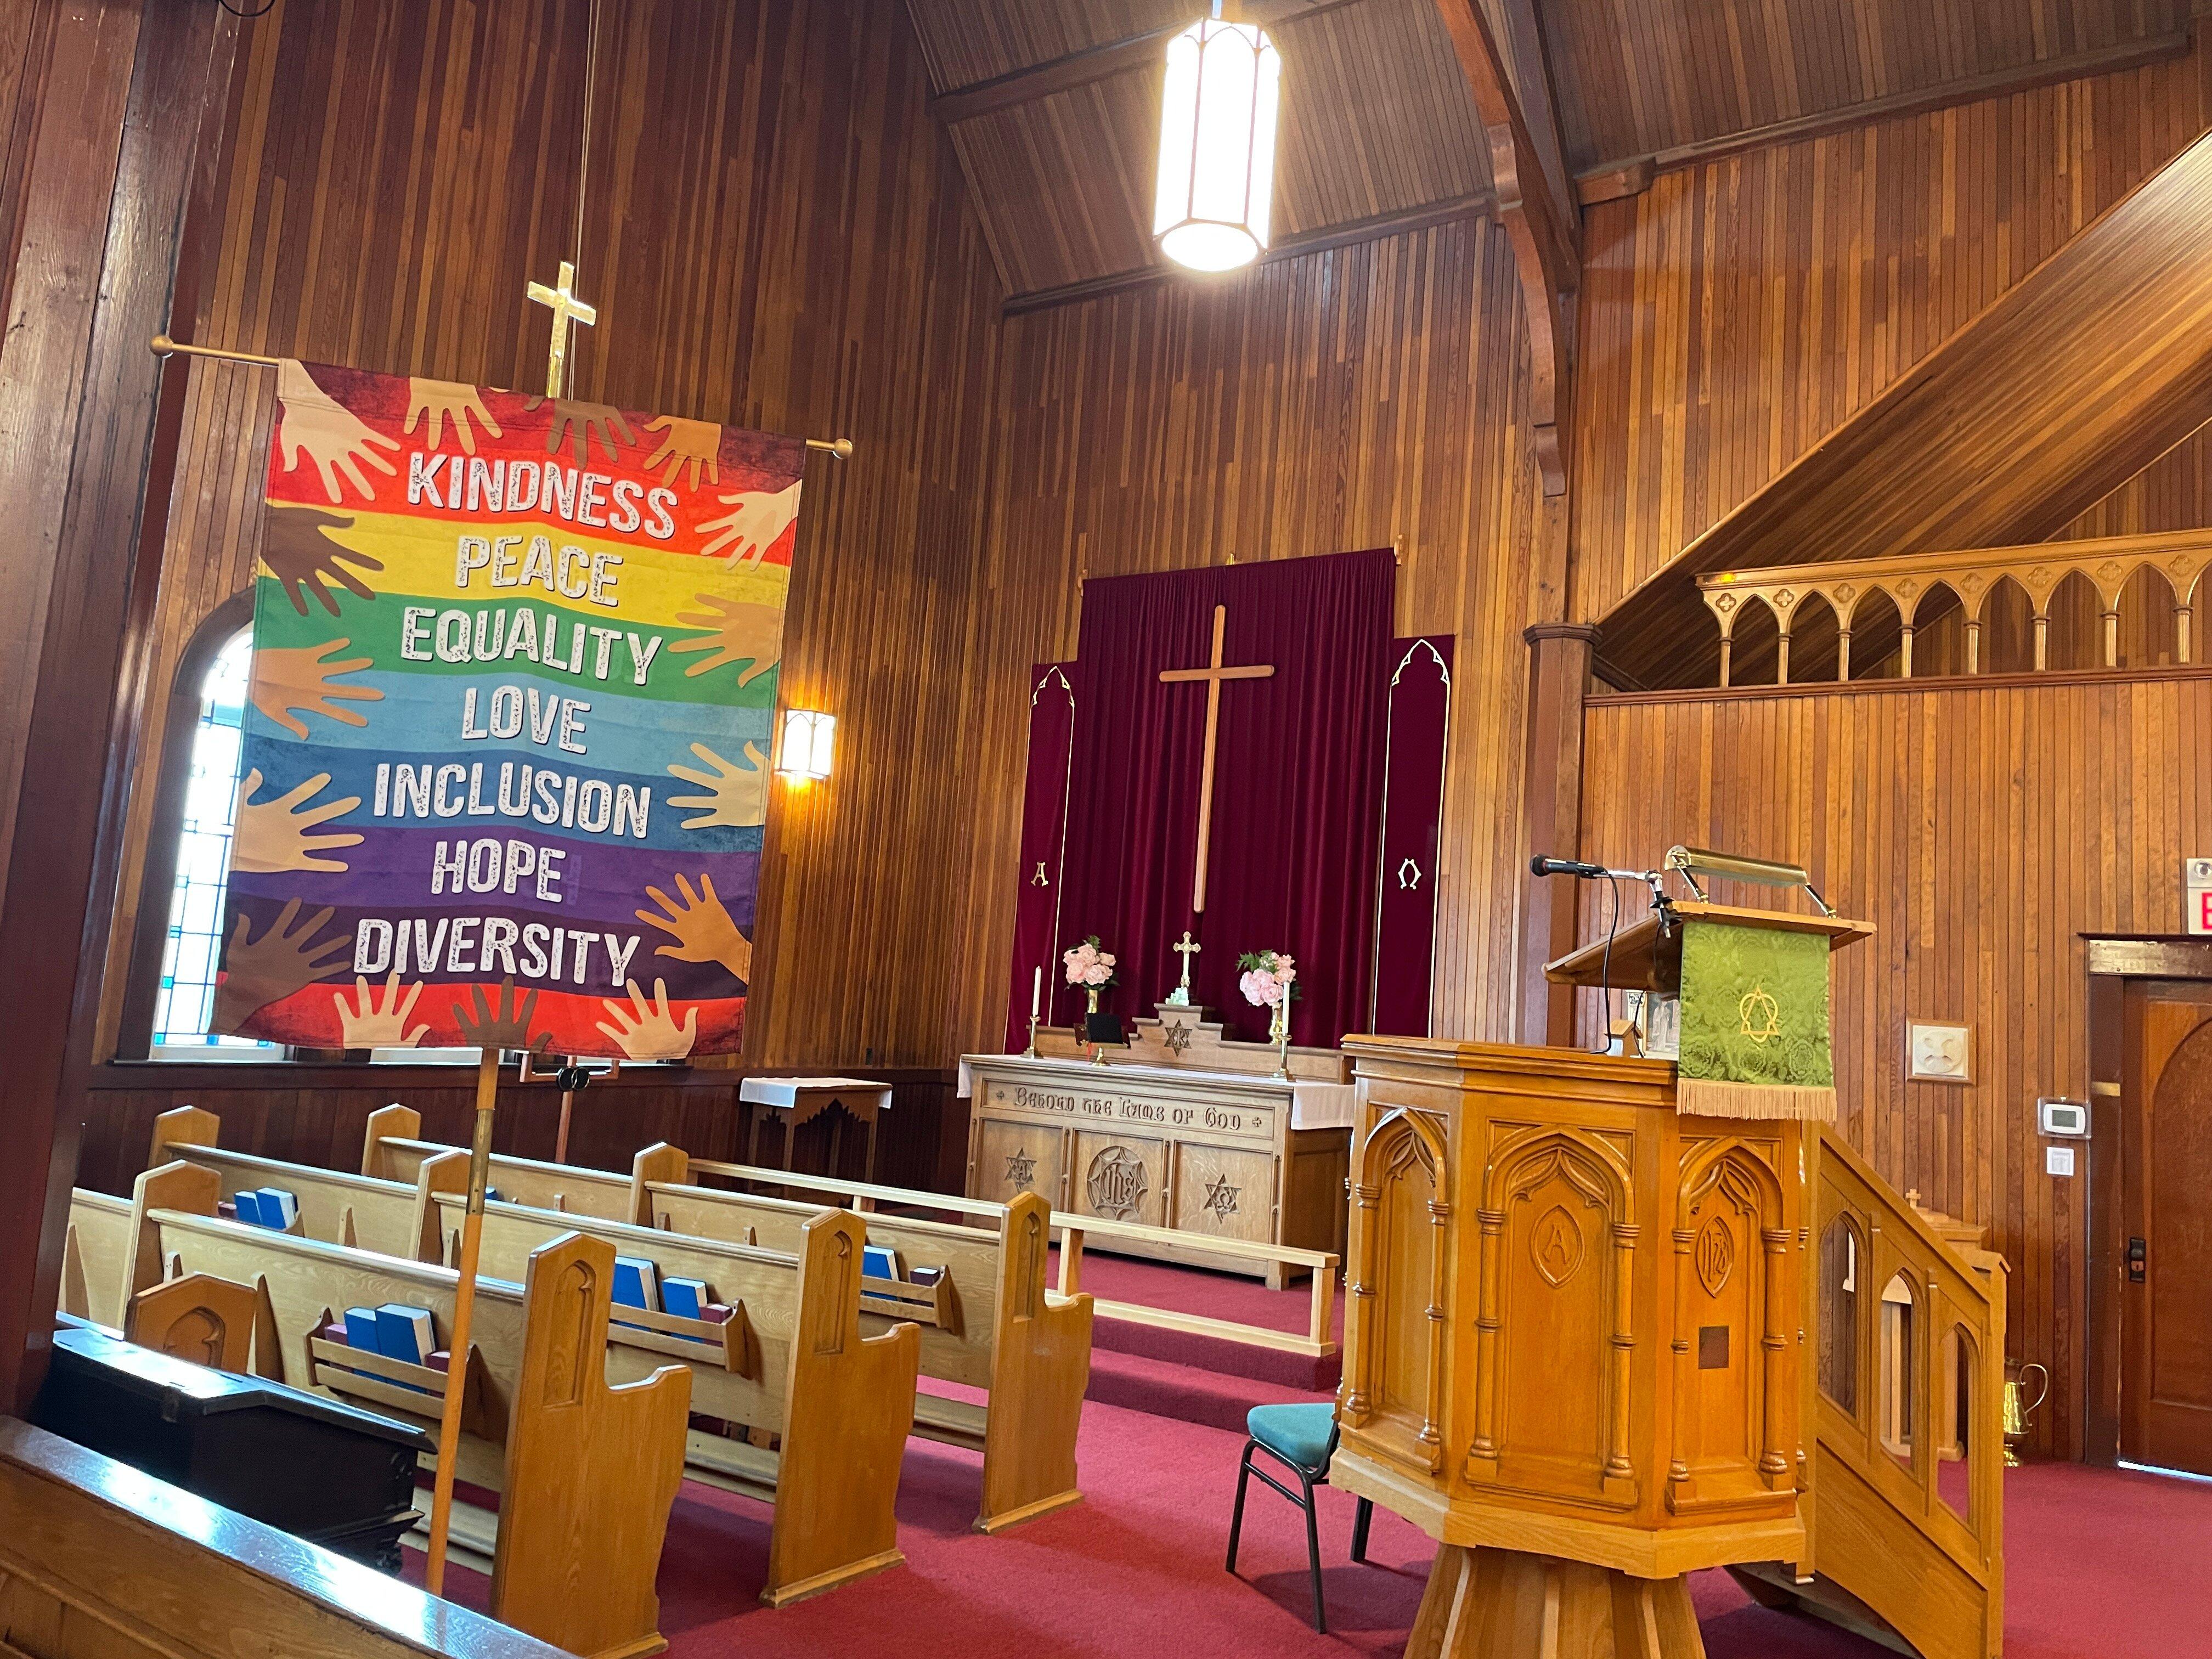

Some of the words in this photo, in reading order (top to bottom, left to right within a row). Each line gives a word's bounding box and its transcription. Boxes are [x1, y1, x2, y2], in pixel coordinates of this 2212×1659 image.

[408, 453, 678, 540] KINDNESS
[455, 535, 623, 607] PEACE
[401, 606, 663, 686] EQUALITY
[461, 685, 592, 754] LOVE
[374, 762, 651, 839] INCLUSION
[431, 838, 566, 902] HOPE
[354, 917, 641, 987] DIVERSITY
